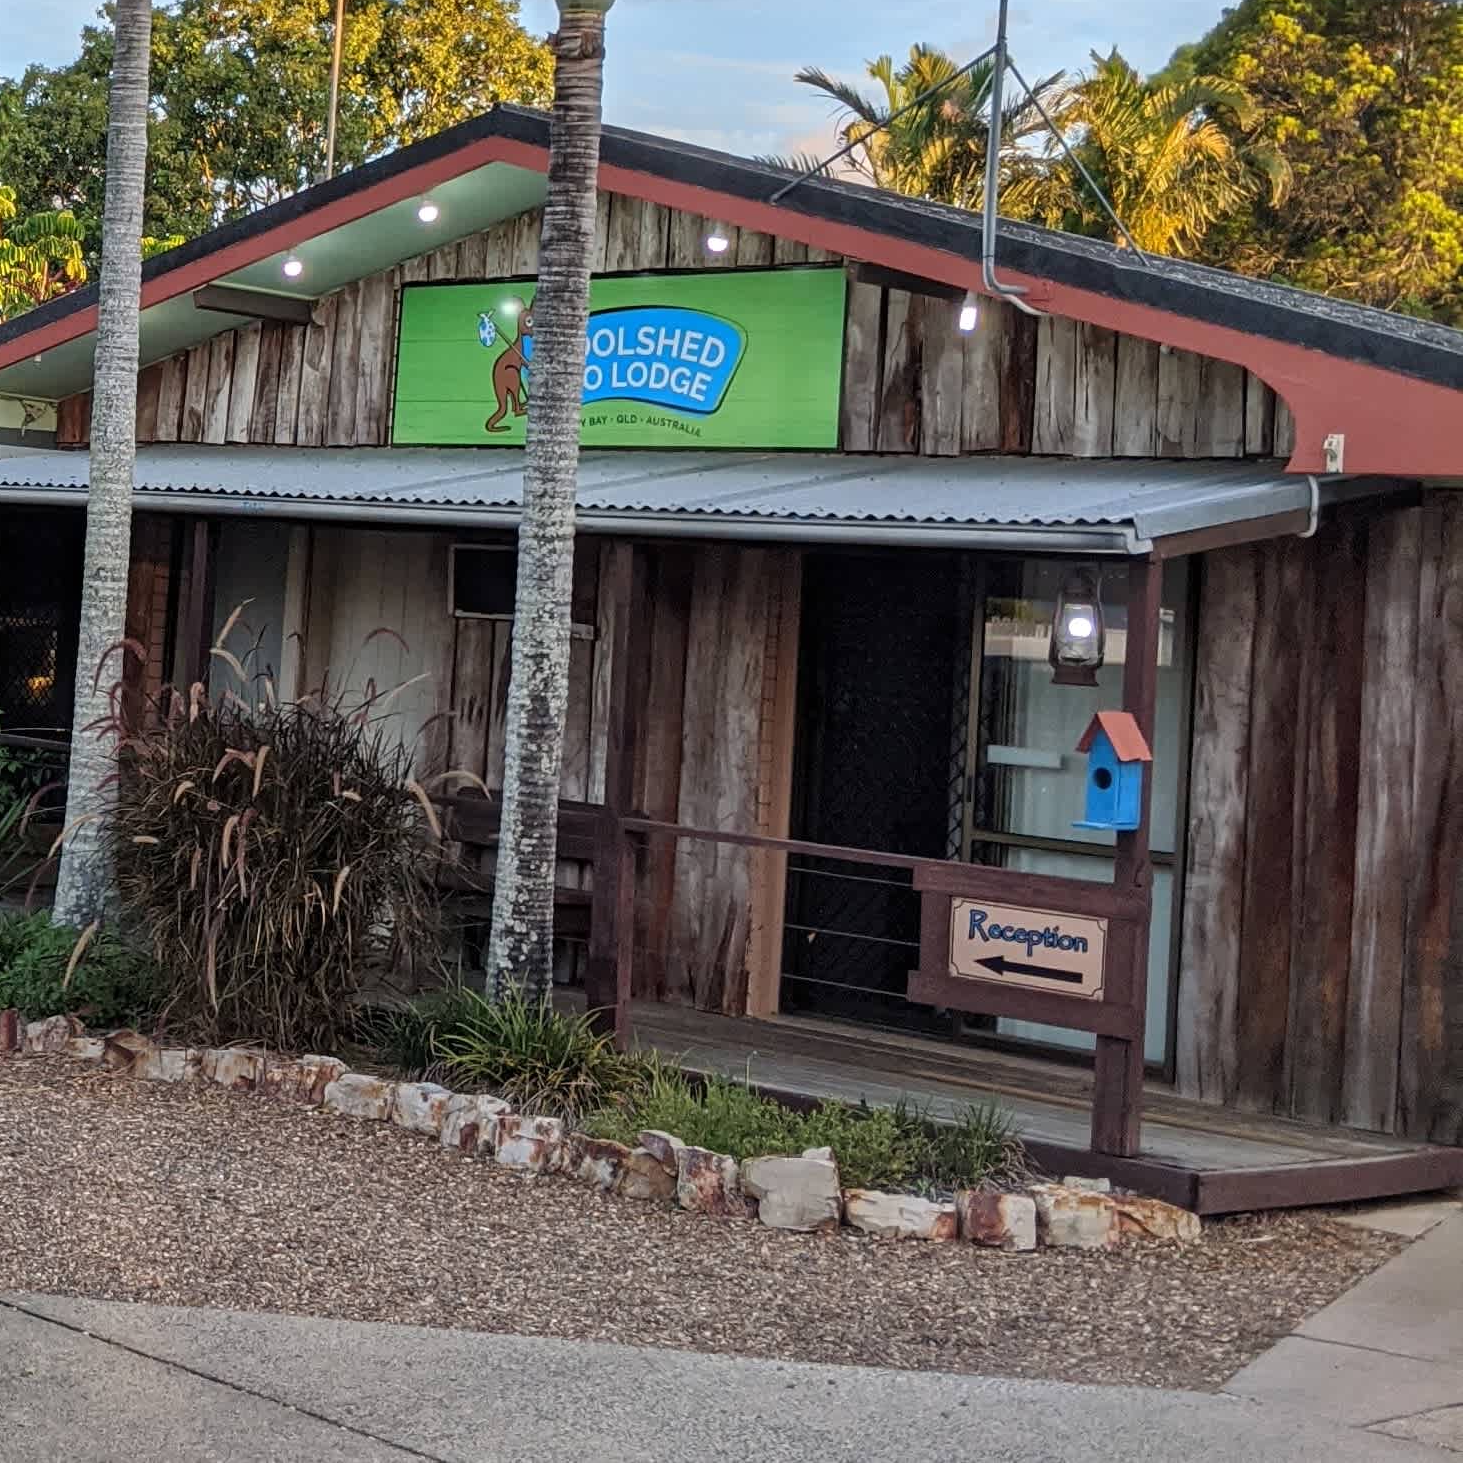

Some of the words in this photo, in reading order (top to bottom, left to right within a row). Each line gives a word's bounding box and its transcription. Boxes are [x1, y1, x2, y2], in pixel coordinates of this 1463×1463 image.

[585, 325, 726, 368] OLSHED
[611, 361, 713, 402] LODGE
[589, 415, 609, 427] BAY
[645, 415, 702, 438] AUSTRALIA
[968, 909, 1089, 957] Reception
